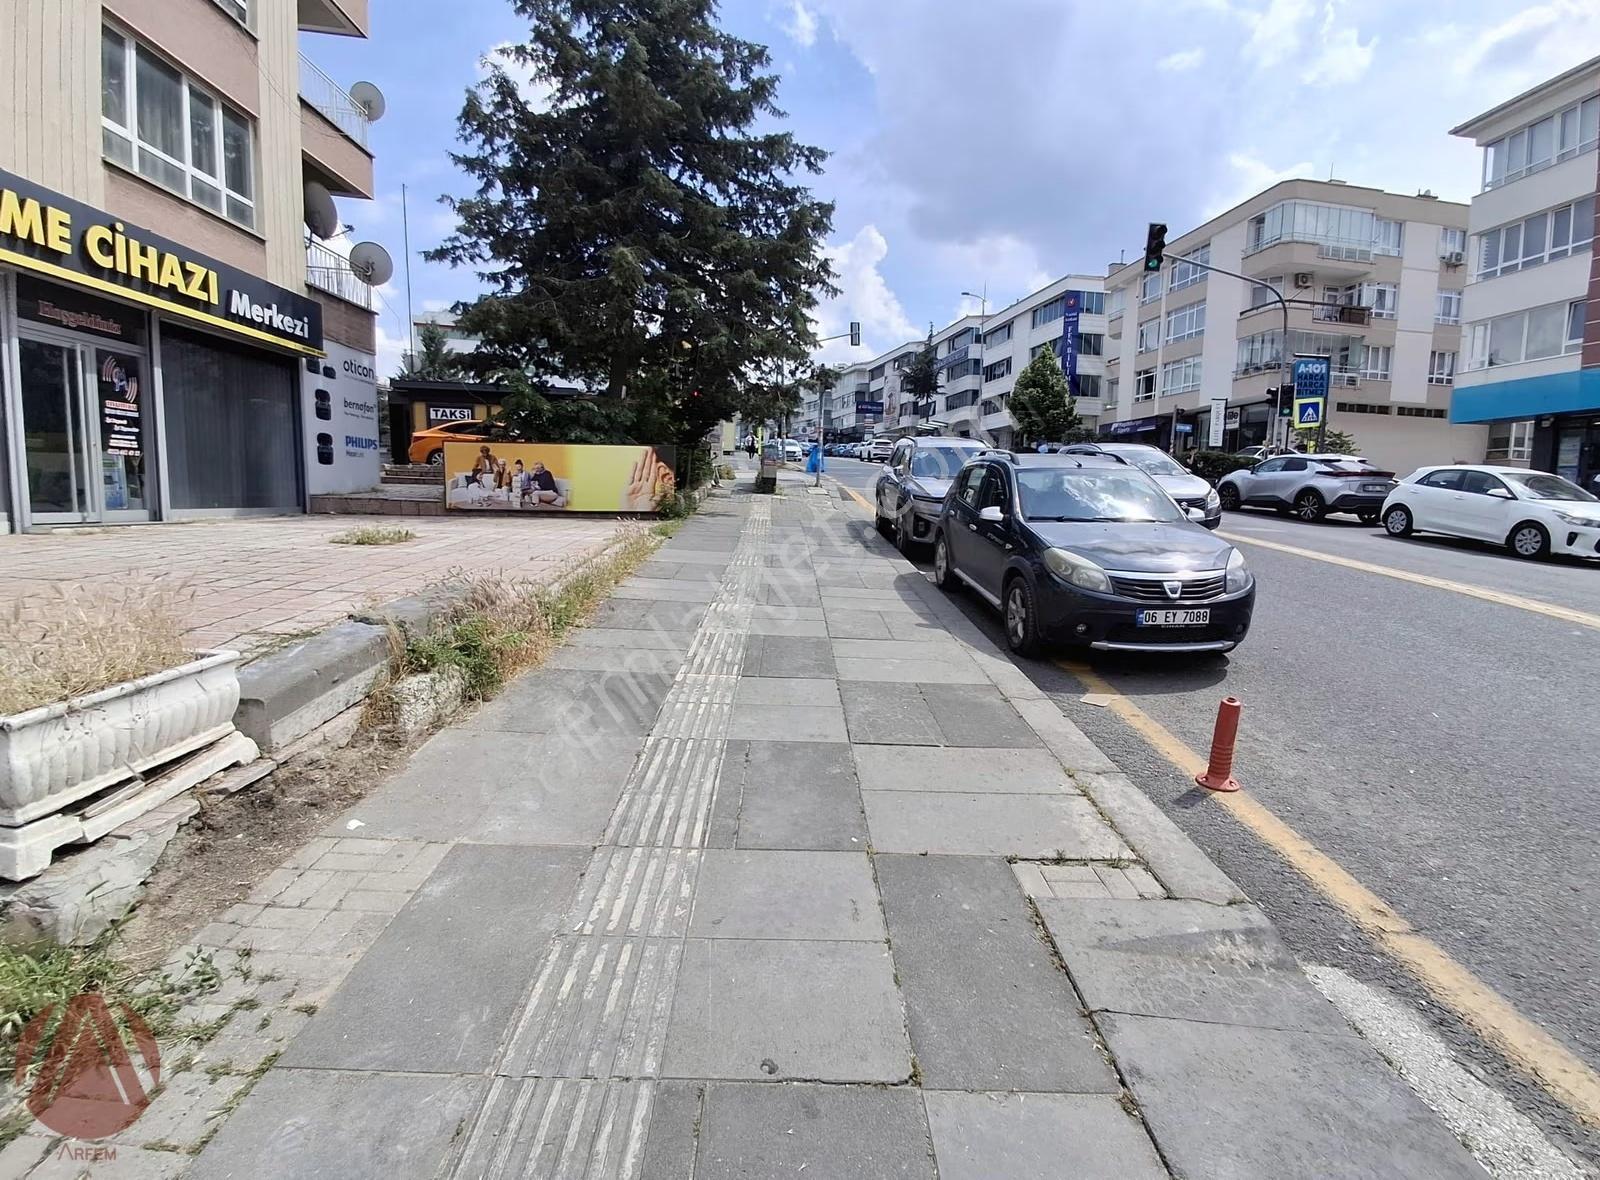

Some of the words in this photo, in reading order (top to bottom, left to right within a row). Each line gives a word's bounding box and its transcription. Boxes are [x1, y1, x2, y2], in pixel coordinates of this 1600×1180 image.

[85, 222, 218, 305] CİHAZI
[230, 290, 309, 338] Merkezi
[343, 359, 375, 380] oticon
[345, 435, 378, 450] PHILIPS
[1144, 611, 1158, 623] 06
[1164, 611, 1177, 623] EY
[1182, 610, 1208, 622] 7088
